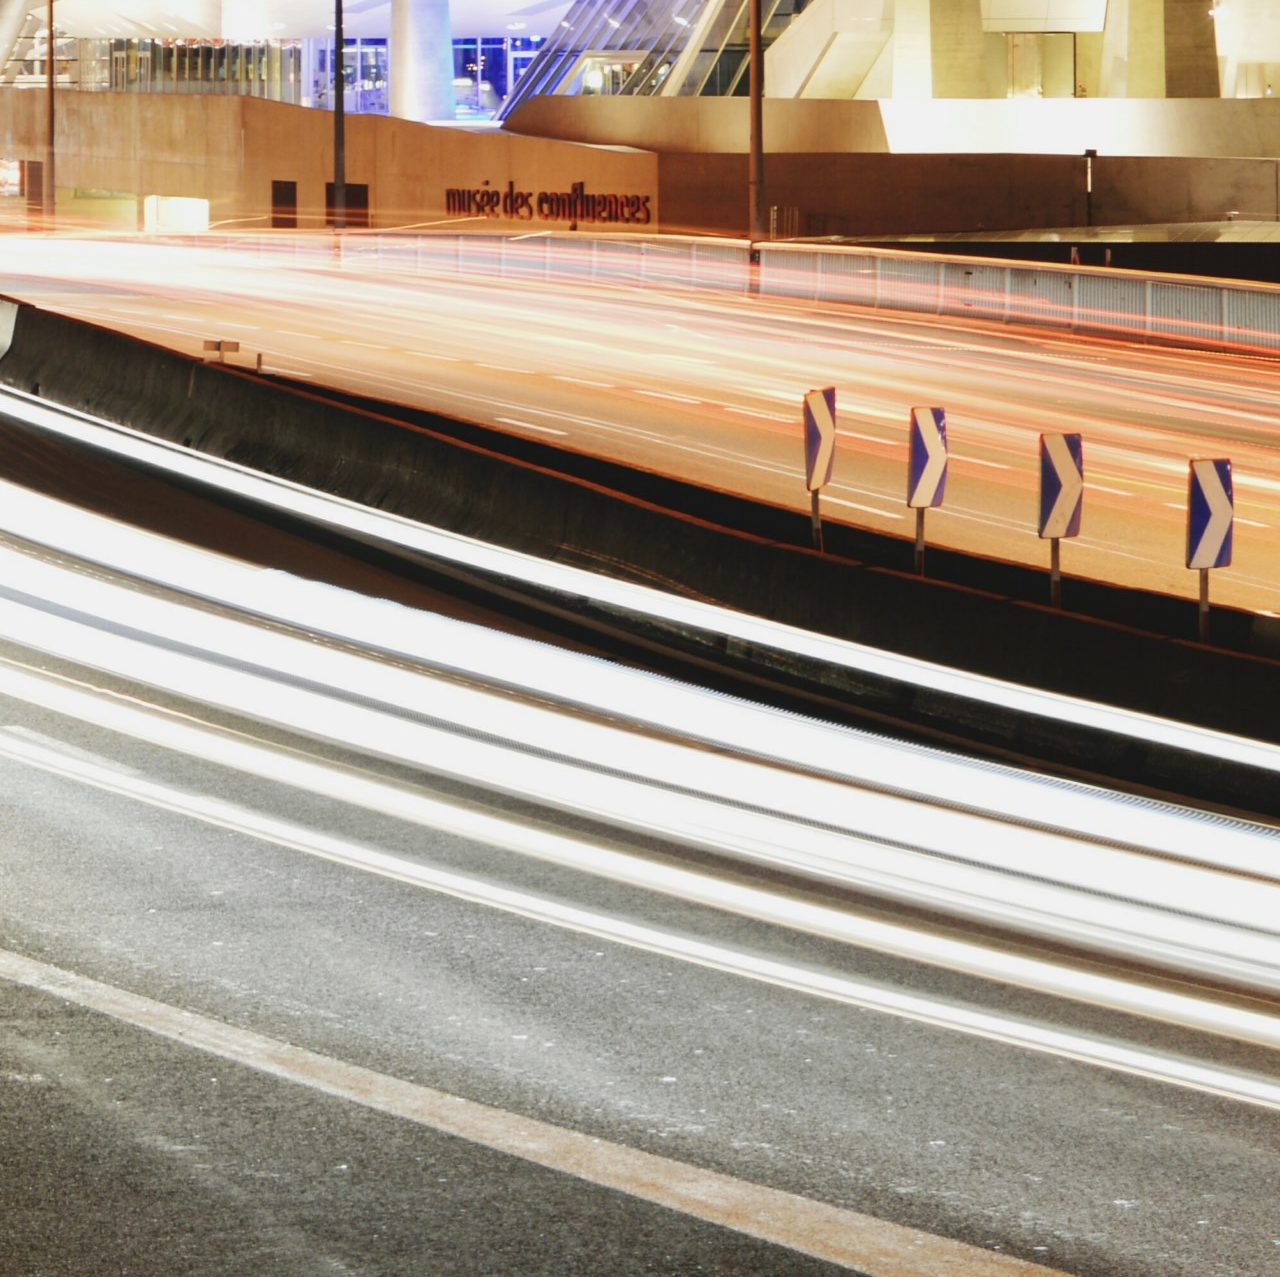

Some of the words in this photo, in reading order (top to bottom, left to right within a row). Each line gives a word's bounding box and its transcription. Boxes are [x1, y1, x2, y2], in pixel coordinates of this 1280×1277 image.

[446, 180, 500, 219] musée
[502, 181, 533, 221] des
[537, 181, 651, 231] confluences
